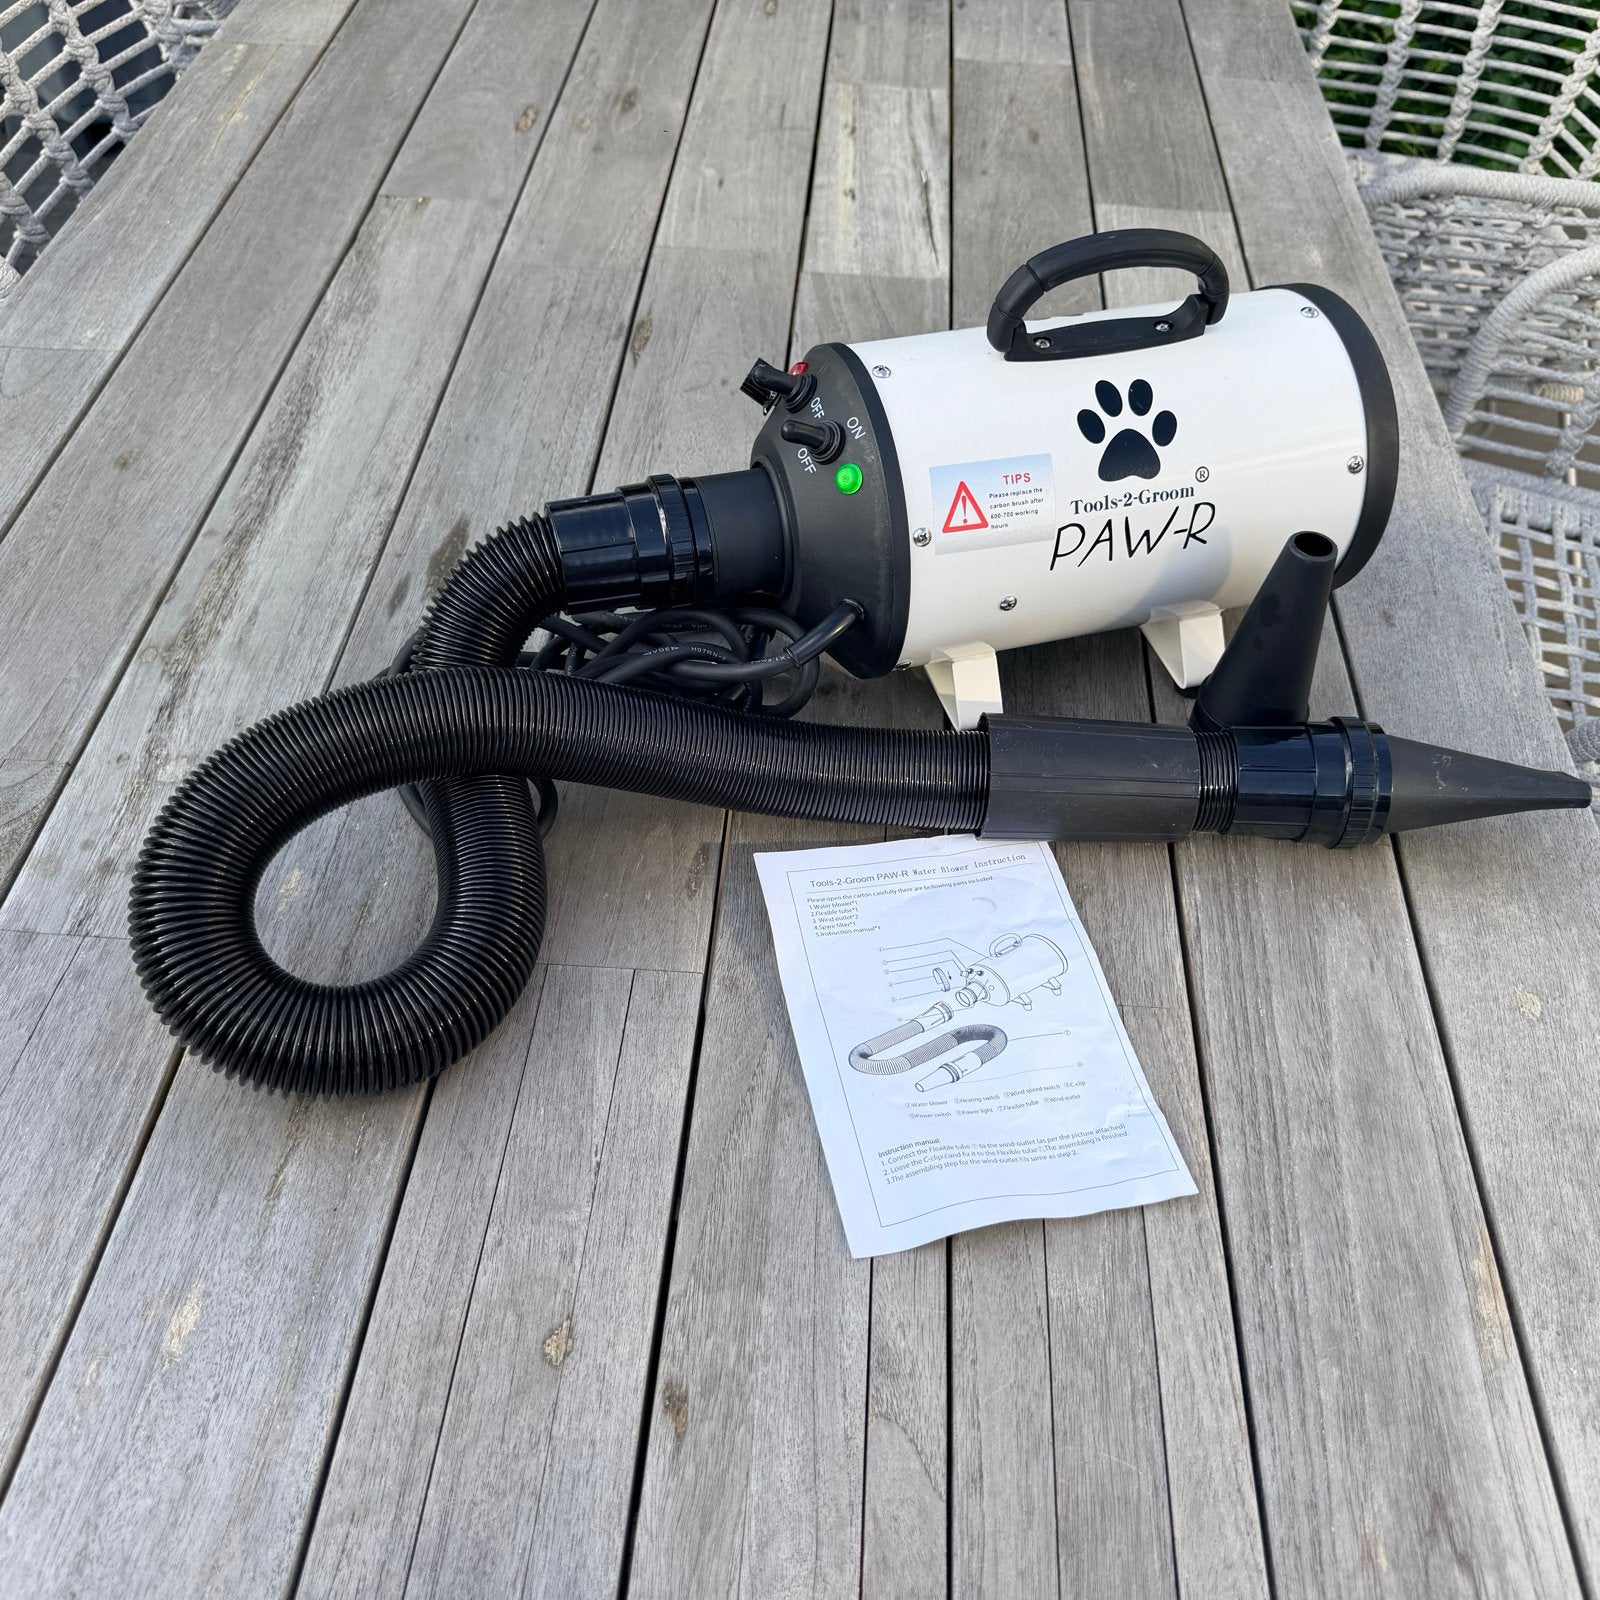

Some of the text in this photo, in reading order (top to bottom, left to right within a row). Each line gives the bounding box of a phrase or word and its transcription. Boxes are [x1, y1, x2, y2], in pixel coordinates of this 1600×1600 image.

[810, 396, 825, 419] OFF
[846, 416, 866, 440] ON
[797, 447, 817, 474] OFF
[1003, 472, 1031, 485] TIPS
[989, 491, 1009, 499] Please
[1010, 488, 1032, 498] replace
[989, 497, 1044, 510] carbon brush after
[1070, 486, 1195, 515] Tools-2-Groom
[1015, 508, 1039, 517] working
[1050, 502, 1216, 571] PAW-R
[810, 854, 1026, 888] Tools-2-Groom PAW-R Water Blower Instruction
[873, 889, 897, 897] carefully
[968, 876, 993, 884] included
[1026, 1086, 1043, 1094] speed
[878, 1142, 914, 1158] Instruction
[887, 1151, 916, 1164] Connect
[916, 1148, 928, 1156] the
[929, 1144, 954, 1152] Flexible
[1016, 1139, 1036, 1147] outlet
[1047, 1136, 1058, 1144] per
[1071, 1130, 1094, 1140] picture
[1095, 1122, 1126, 1134] attached)
[890, 1163, 910, 1174] Loose
[911, 1159, 923, 1167] the
[1058, 1138, 1095, 1150] assembling
[1101, 1130, 1130, 1141] finished.
[905, 1163, 943, 1179] assembling
[943, 1160, 959, 1168] step
[1030, 1154, 1047, 1162] same
[1056, 1151, 1071, 1160] step
